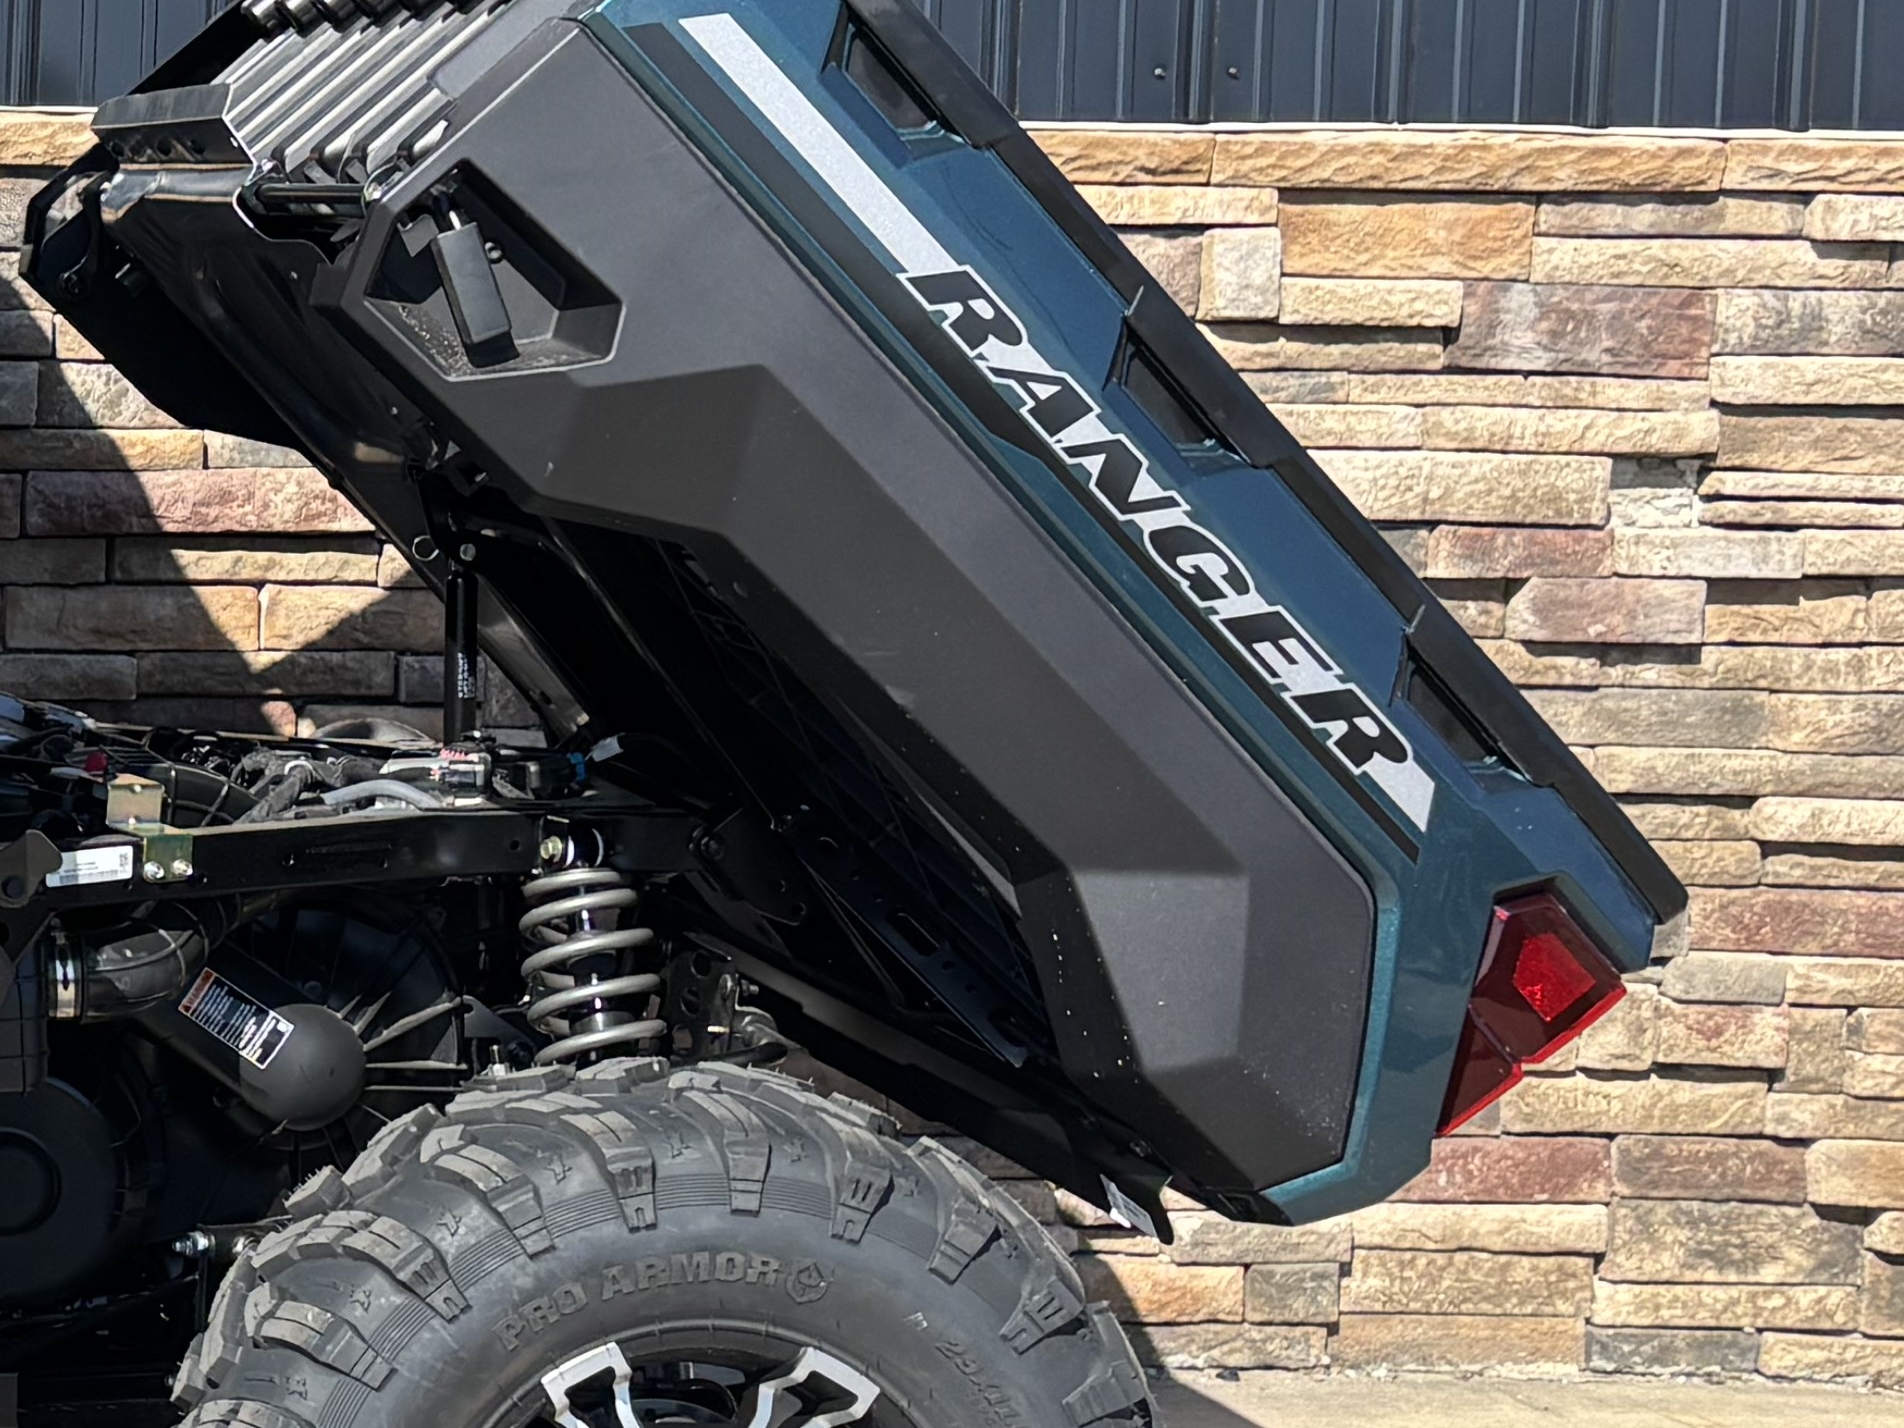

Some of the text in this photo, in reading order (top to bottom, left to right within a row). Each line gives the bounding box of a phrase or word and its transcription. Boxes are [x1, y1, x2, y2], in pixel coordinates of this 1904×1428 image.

[896, 265, 1413, 775] RANGER
[492, 1251, 785, 1353] PRO ARMOR
